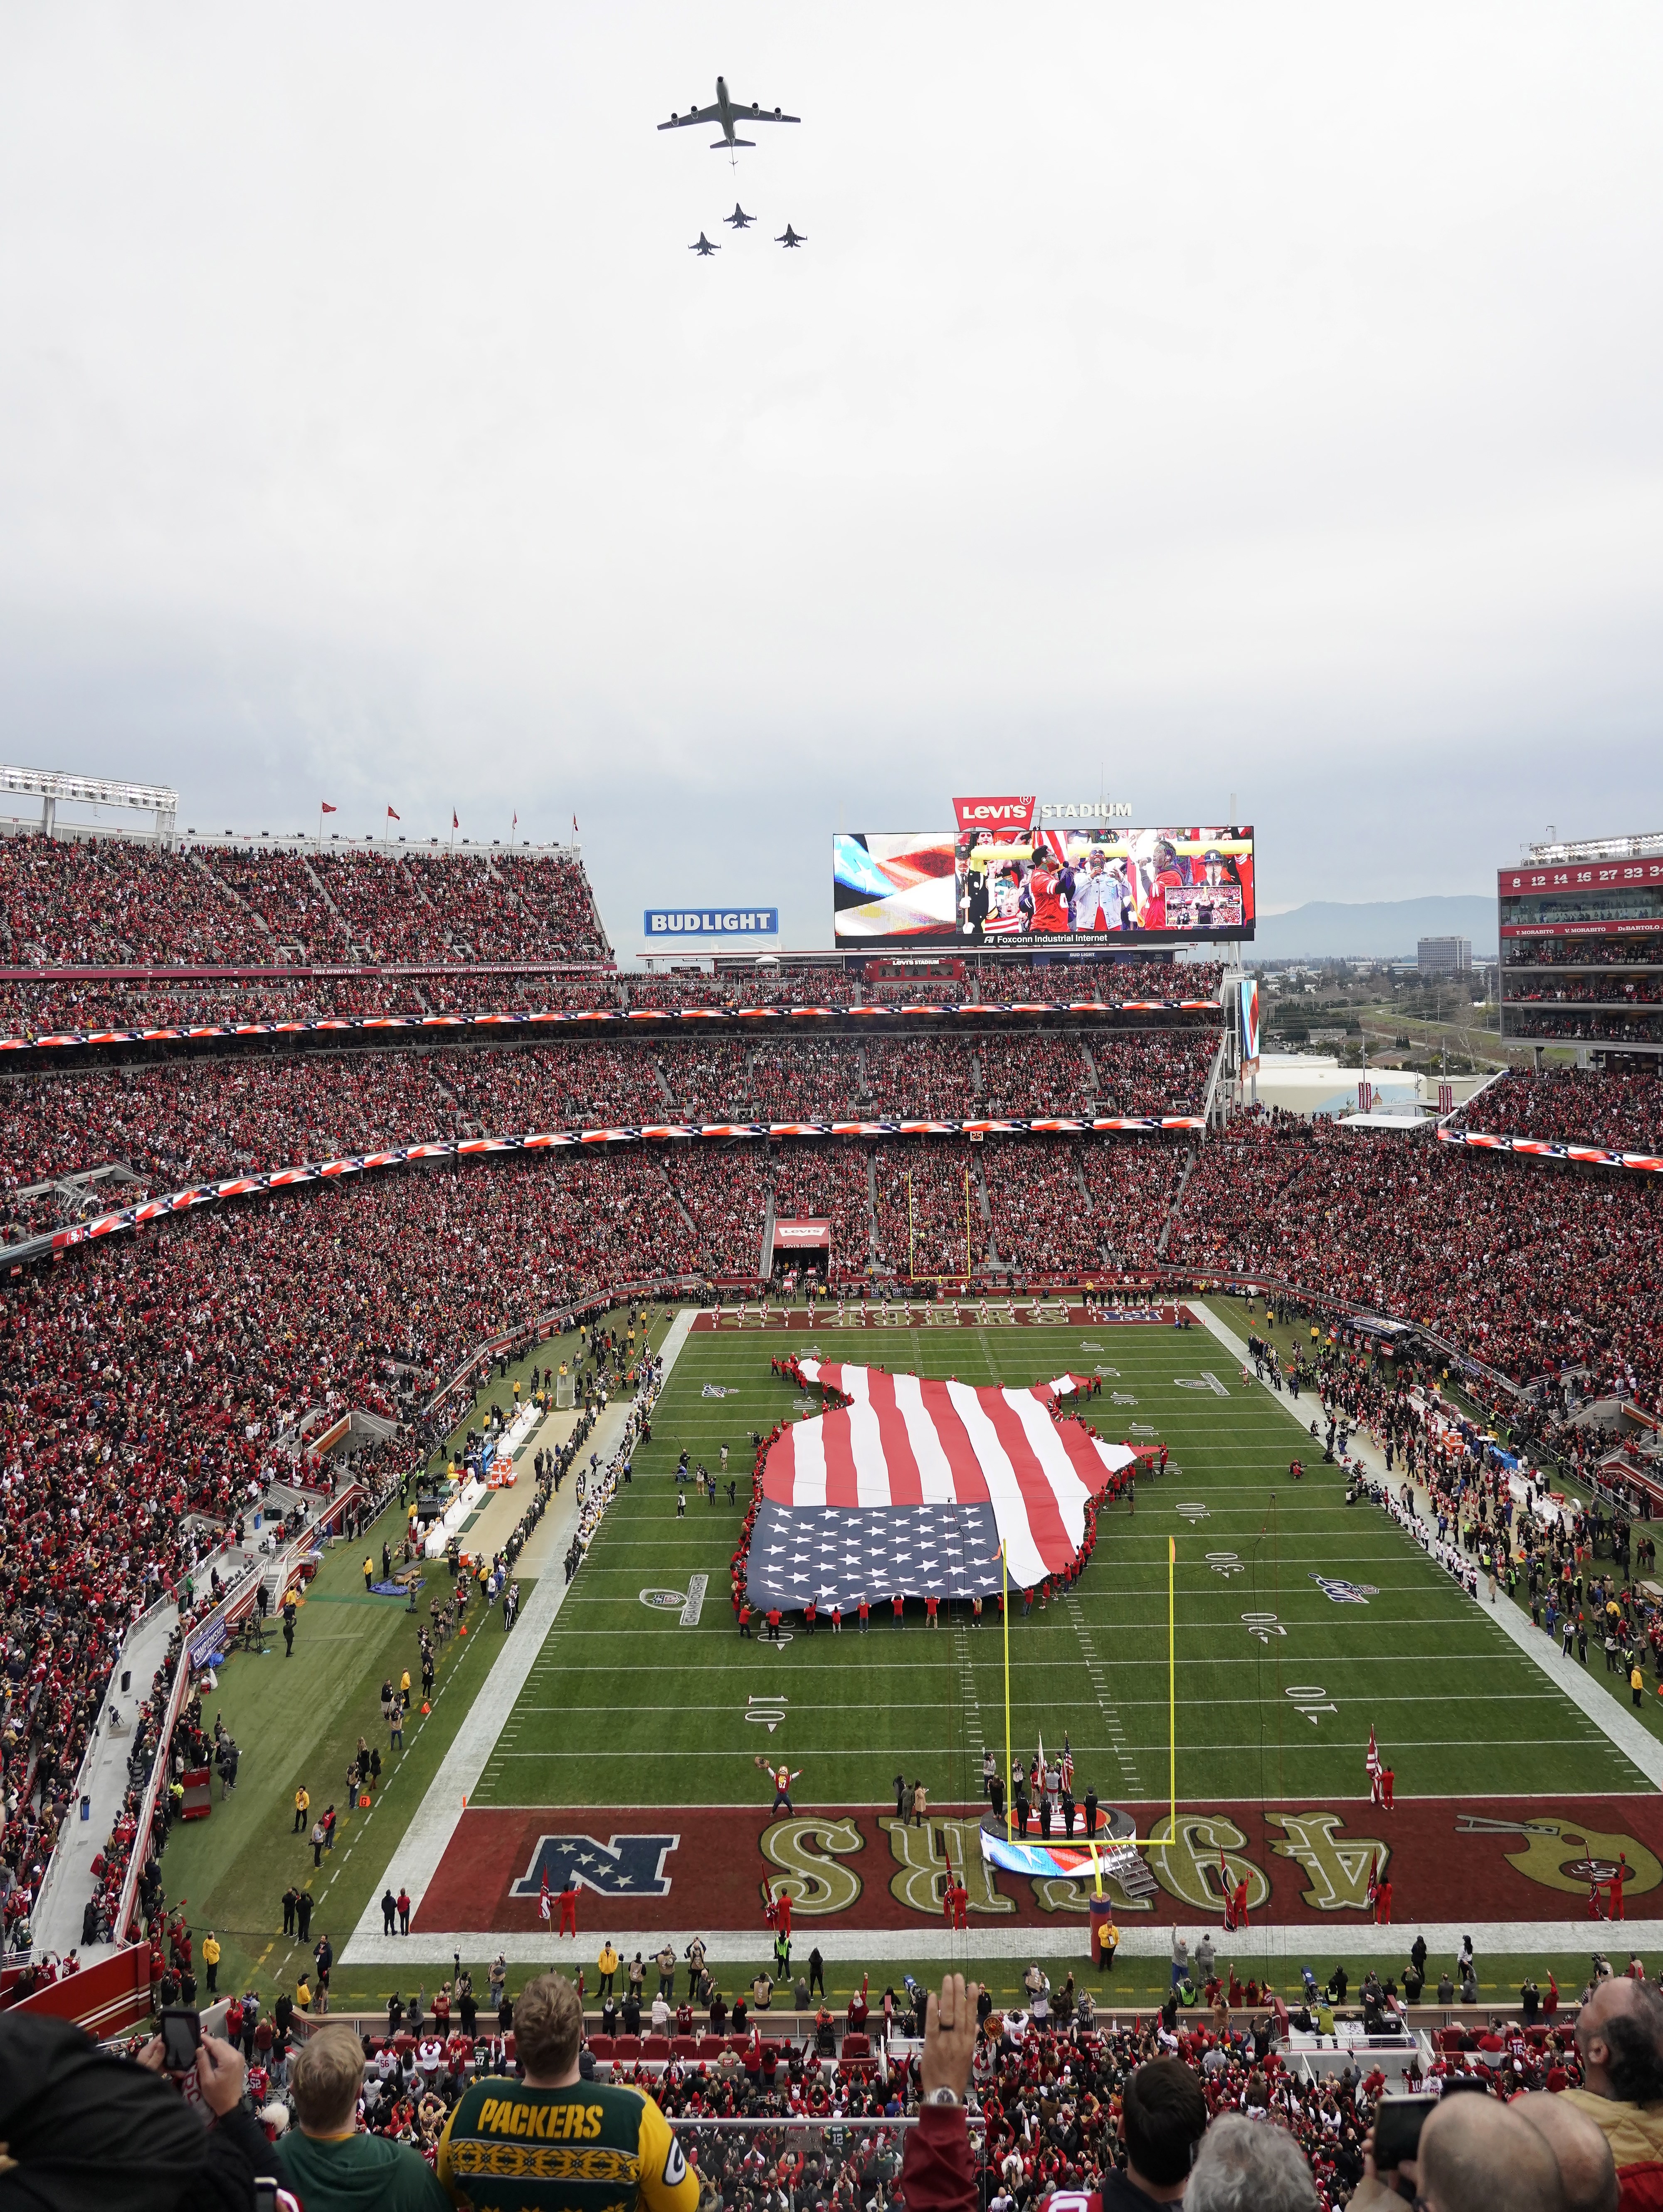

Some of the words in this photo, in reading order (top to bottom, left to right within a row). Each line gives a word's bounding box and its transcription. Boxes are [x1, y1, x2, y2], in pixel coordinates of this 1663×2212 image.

[1041, 803, 1132, 818] STADIUM
[1512, 878, 1521, 887] 8
[1531, 876, 1546, 886] 12
[1554, 874, 1568, 884] 14
[1577, 872, 1591, 882] 16
[1599, 870, 1617, 880] 27
[1624, 867, 1643, 879] 33
[793, 1399, 817, 1409] 30
[1110, 1395, 1138, 1404] 30
[1128, 1426, 1160, 1437] 40
[1175, 1503, 1211, 1519] 40
[1205, 1552, 1244, 1572] 30
[685, 1576, 706, 1624] CHAMPIONSHIP
[1241, 1613, 1287, 1635] 20
[194, 1625, 225, 1664] CHAMPIONSHIP
[1285, 1686, 1338, 1713] 10
[745, 1695, 789, 1722] 10
[361, 1797, 367, 1806] G
[1513, 2045, 1522, 2055] 16
[380, 2059, 389, 2068] 56
[475, 2056, 484, 2066] 37
[250, 2078, 262, 2089] 52
[1412, 2081, 1420, 2091] 10
[477, 2098, 603, 2140] PACKERS
[832, 2133, 844, 2145] 12
